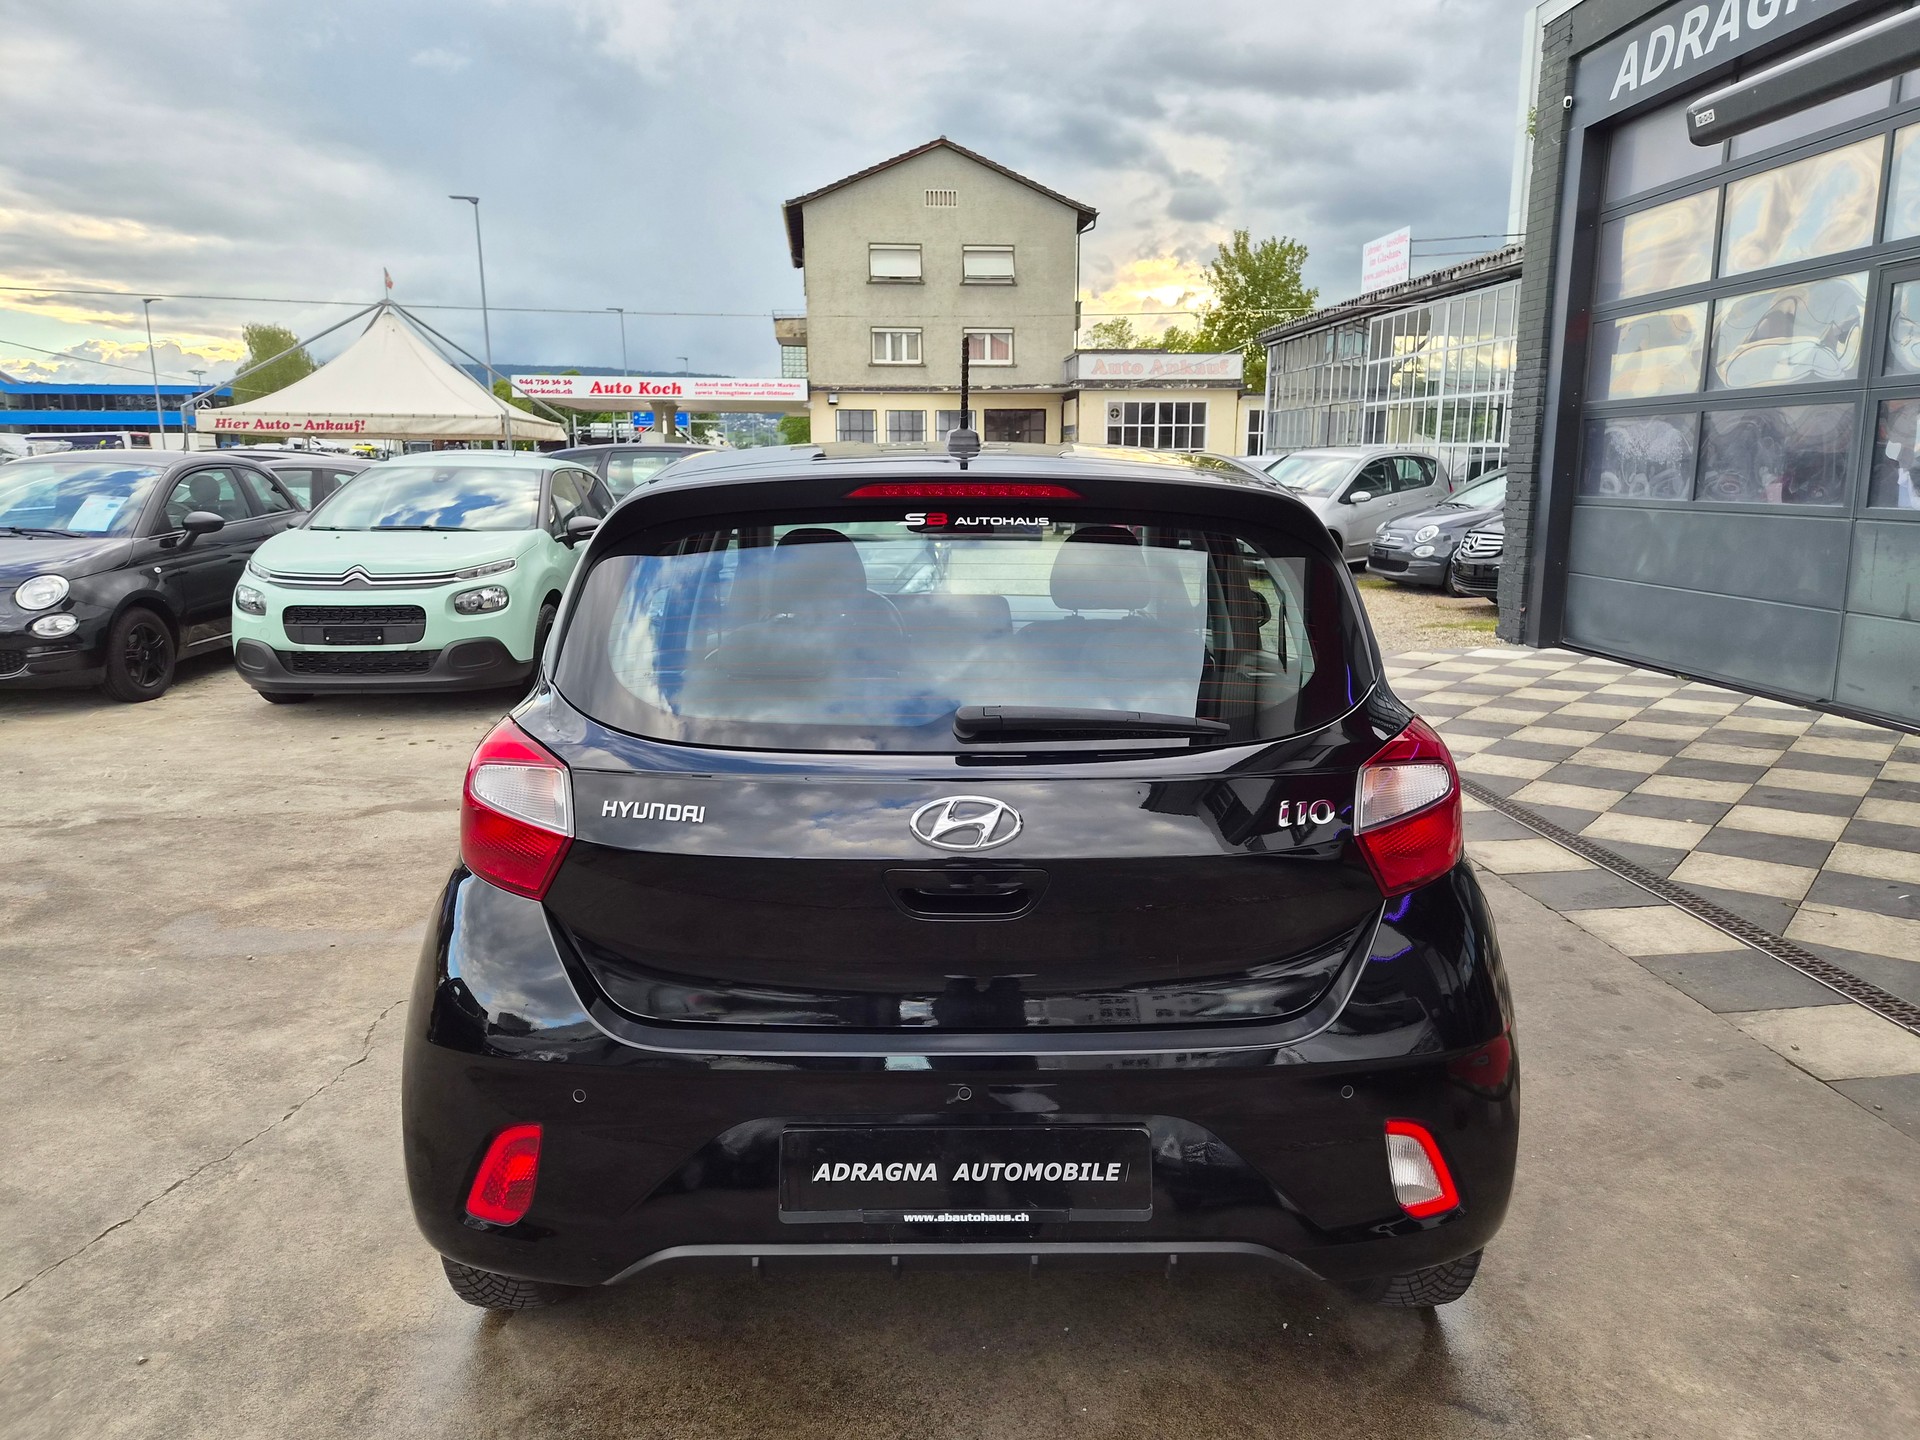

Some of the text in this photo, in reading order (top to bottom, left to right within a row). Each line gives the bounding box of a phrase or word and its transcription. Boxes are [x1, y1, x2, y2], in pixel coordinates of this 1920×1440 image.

[1609, 0, 1815, 101] ADRAG
[1091, 358, 1230, 375] Auto Ankauf
[590, 381, 682, 395] Auto Koch
[215, 418, 250, 429] Hier
[896, 512, 1050, 526] SB AUTOHAUS
[601, 800, 706, 823] HYUNDAI
[1278, 800, 1336, 828] i10
[813, 1162, 1121, 1182] ADRAGNA AUTOMOBILE
[903, 1212, 1030, 1223] www.sbautohaus.ch
